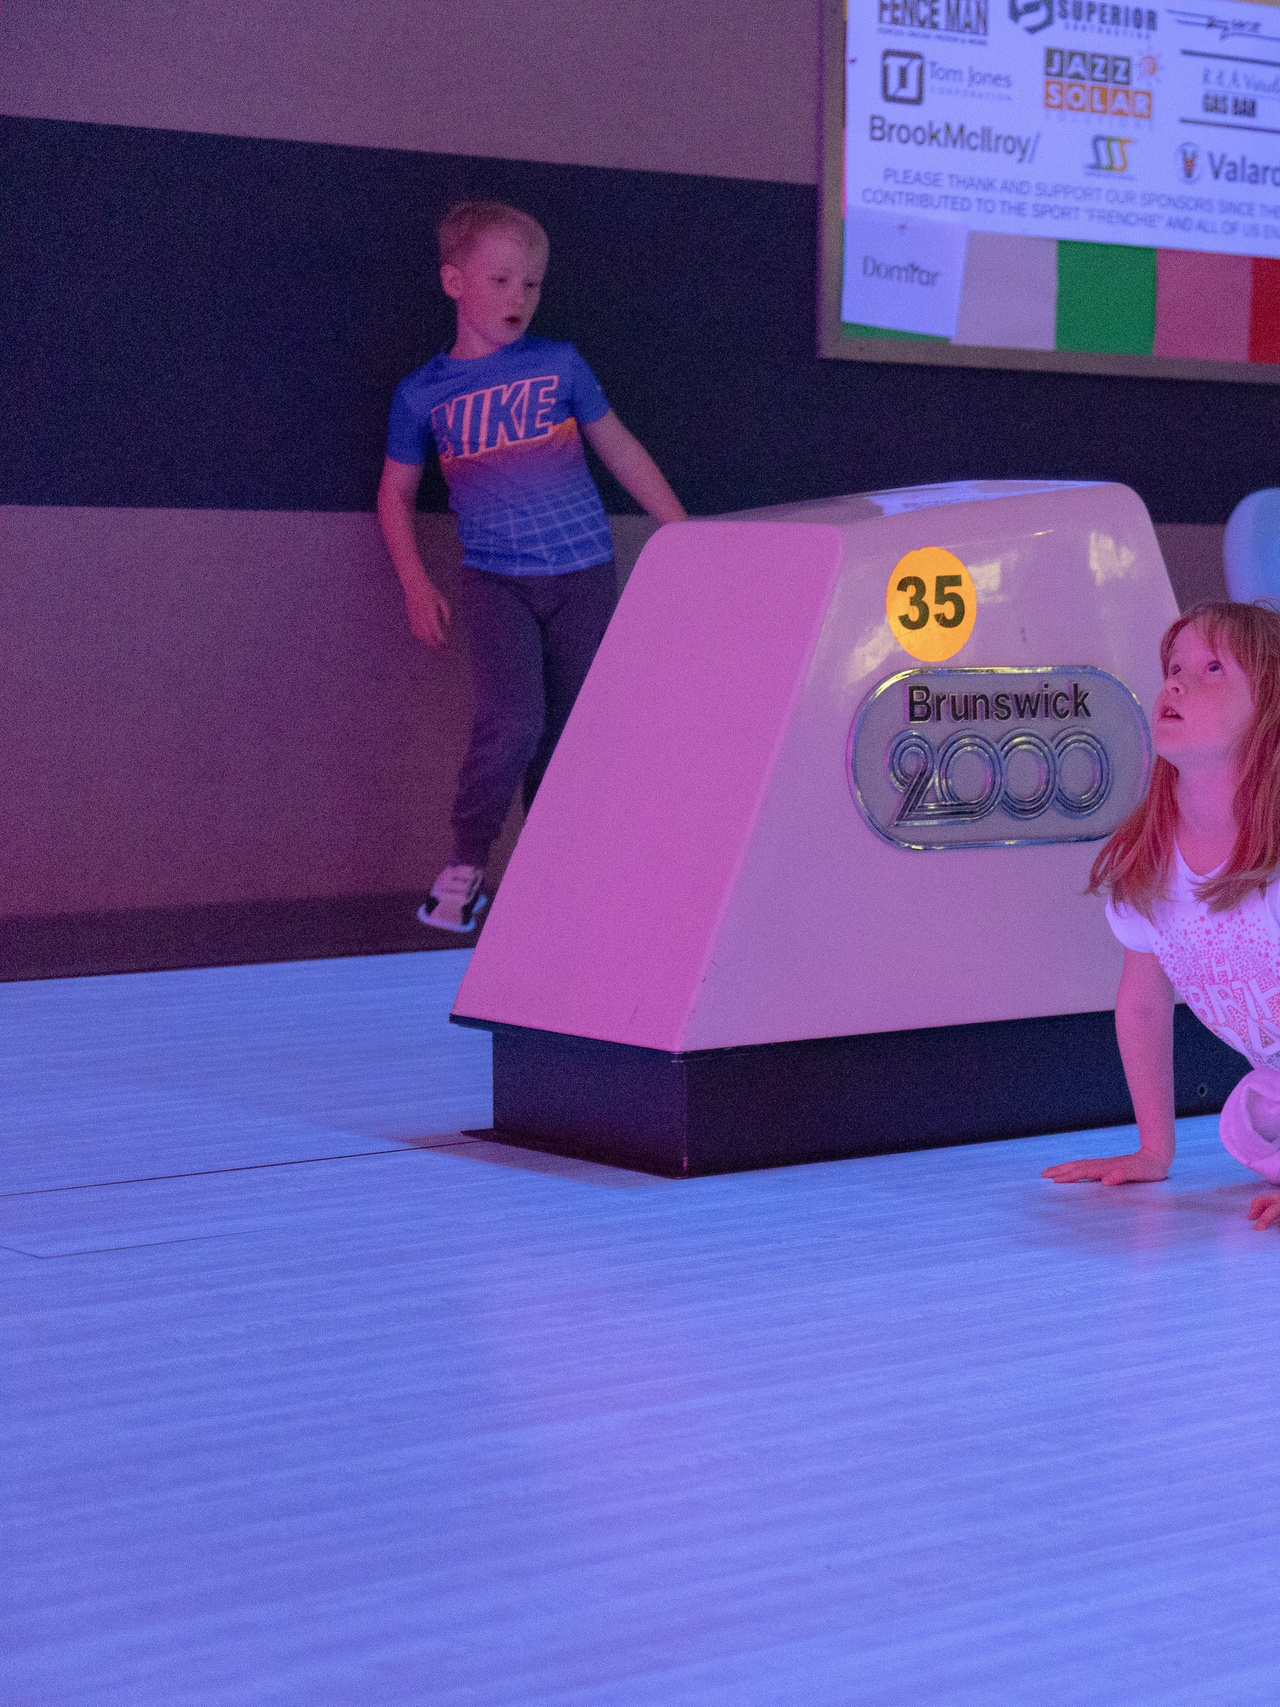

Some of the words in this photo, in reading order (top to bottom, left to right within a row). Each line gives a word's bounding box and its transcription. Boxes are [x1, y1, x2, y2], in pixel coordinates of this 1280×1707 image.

[1057, 0, 1157, 31] SUPERIOR
[929, 61, 963, 82] Tom
[967, 65, 1012, 88] Jones
[1045, 48, 1131, 86] JAZZ
[1044, 79, 1153, 120] SOLAR
[862, 188, 970, 212] CONTRIBUTED
[976, 196, 997, 215] TO
[1001, 199, 1028, 217] THE
[1031, 202, 1080, 221] SPORT
[1165, 215, 1194, 232] AND
[1197, 217, 1218, 234] ALL
[1220, 219, 1240, 237] OF
[1242, 222, 1260, 238] US
[883, 167, 944, 188] PLEASE
[948, 172, 998, 193] THANK
[1001, 177, 1031, 196] AND
[1034, 180, 1102, 200] SUPPORT
[1105, 187, 1137, 204] OUR
[1140, 190, 1215, 214] SPONSORS
[1218, 198, 1256, 217] SINCE
[862, 255, 941, 287] Domtar
[430, 375, 560, 461] NIKE
[896, 574, 966, 631] 35
[906, 681, 1093, 724] Brunswick
[888, 726, 1115, 828] 2000
